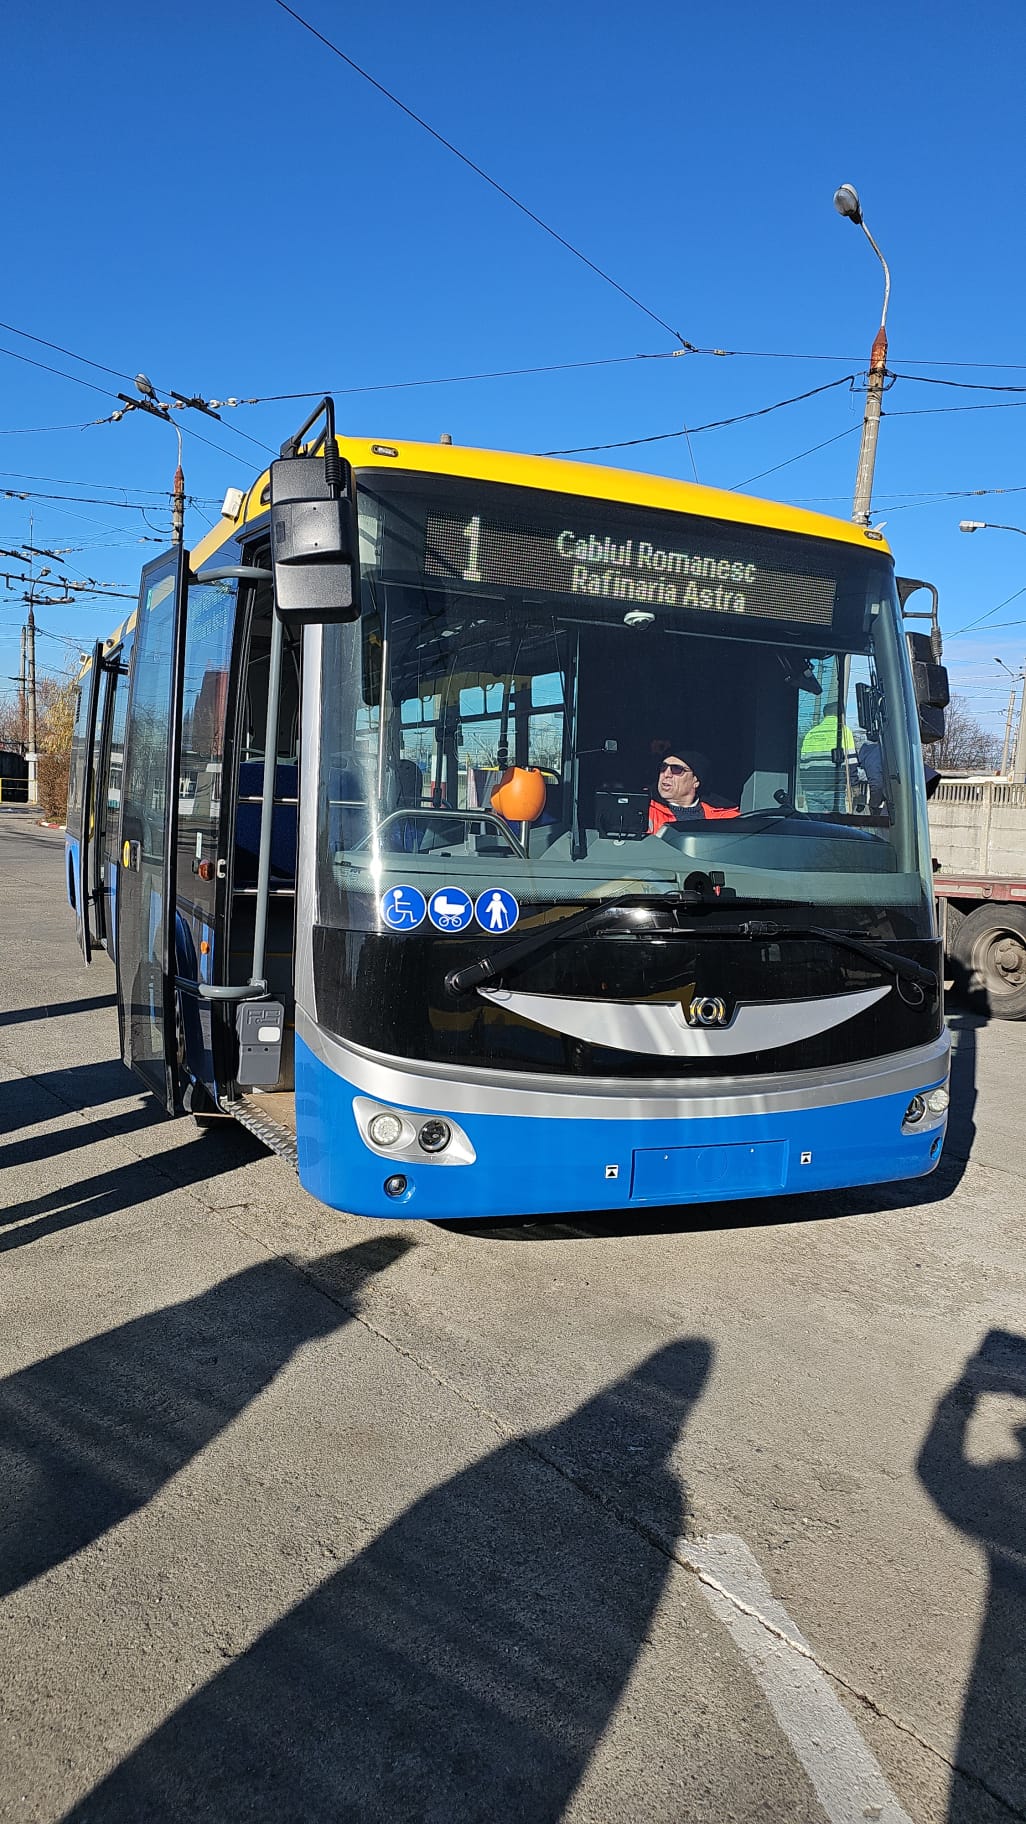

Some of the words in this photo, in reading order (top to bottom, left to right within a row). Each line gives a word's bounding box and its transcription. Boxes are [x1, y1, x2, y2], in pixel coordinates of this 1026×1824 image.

[463, 516, 481, 582] 1
[557, 530, 633, 566] Cablul
[638, 541, 757, 583] Romanesc
[572, 565, 676, 605] Rafinaria
[683, 580, 746, 613] Astra
